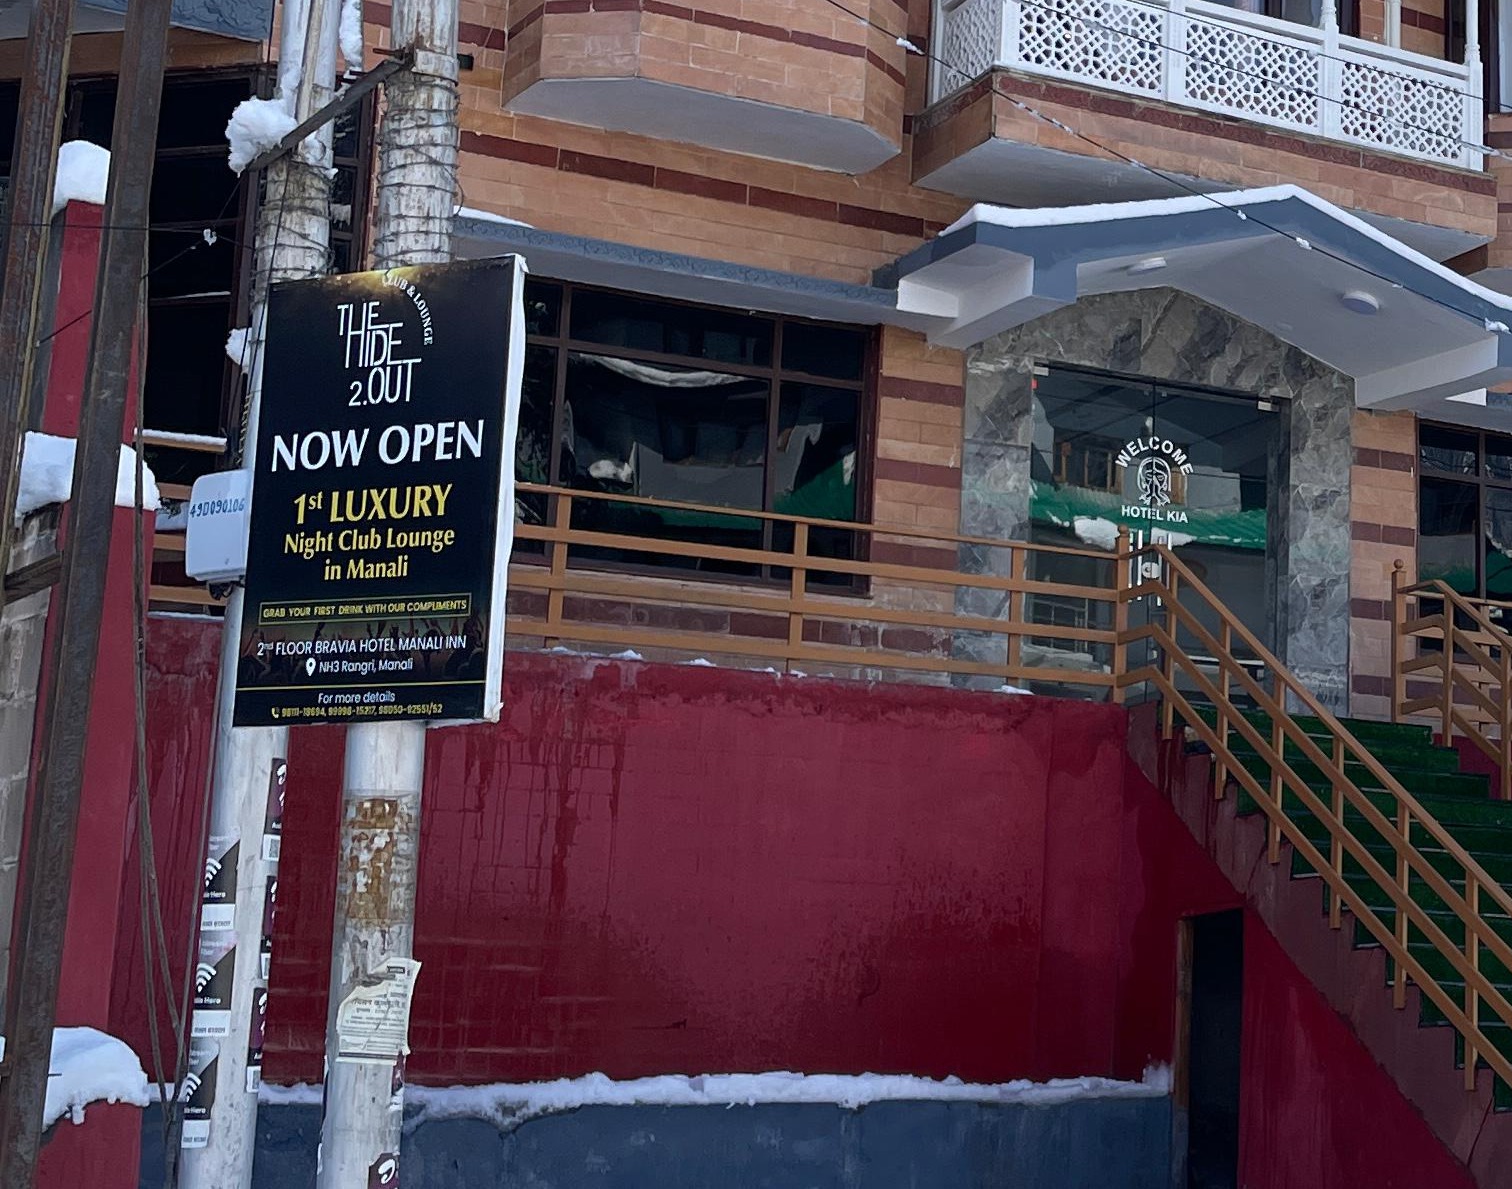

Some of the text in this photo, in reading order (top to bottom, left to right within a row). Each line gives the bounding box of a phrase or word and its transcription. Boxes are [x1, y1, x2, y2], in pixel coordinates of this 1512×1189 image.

[406, 285, 416, 297] &
[413, 293, 433, 346] LOUNGE
[345, 312, 404, 368] HIDE
[271, 419, 484, 472] NOW OPEN
[1115, 436, 1194, 476] WELCOME
[294, 483, 452, 525] 1st LUXURY
[1121, 504, 1188, 523] HOTEL KIA
[284, 527, 455, 560] Night Club Lounge
[324, 555, 408, 580] in Manali
[263, 607, 286, 618] GRAB
[289, 607, 311, 617] YOUR
[314, 606, 335, 616] FIRST
[338, 604, 364, 615] DRINK
[365, 603, 387, 614] WITH
[388, 603, 406, 613] OUR
[275, 641, 312, 656] FLOOR
[315, 639, 357, 654] BRAVIA
[360, 637, 396, 653] HOTEL
[399, 635, 443, 651] MANALI
[445, 634, 467, 649] INN
[319, 658, 413, 676] NH3 Rangri, Manali
[318, 690, 395, 704] For more details
